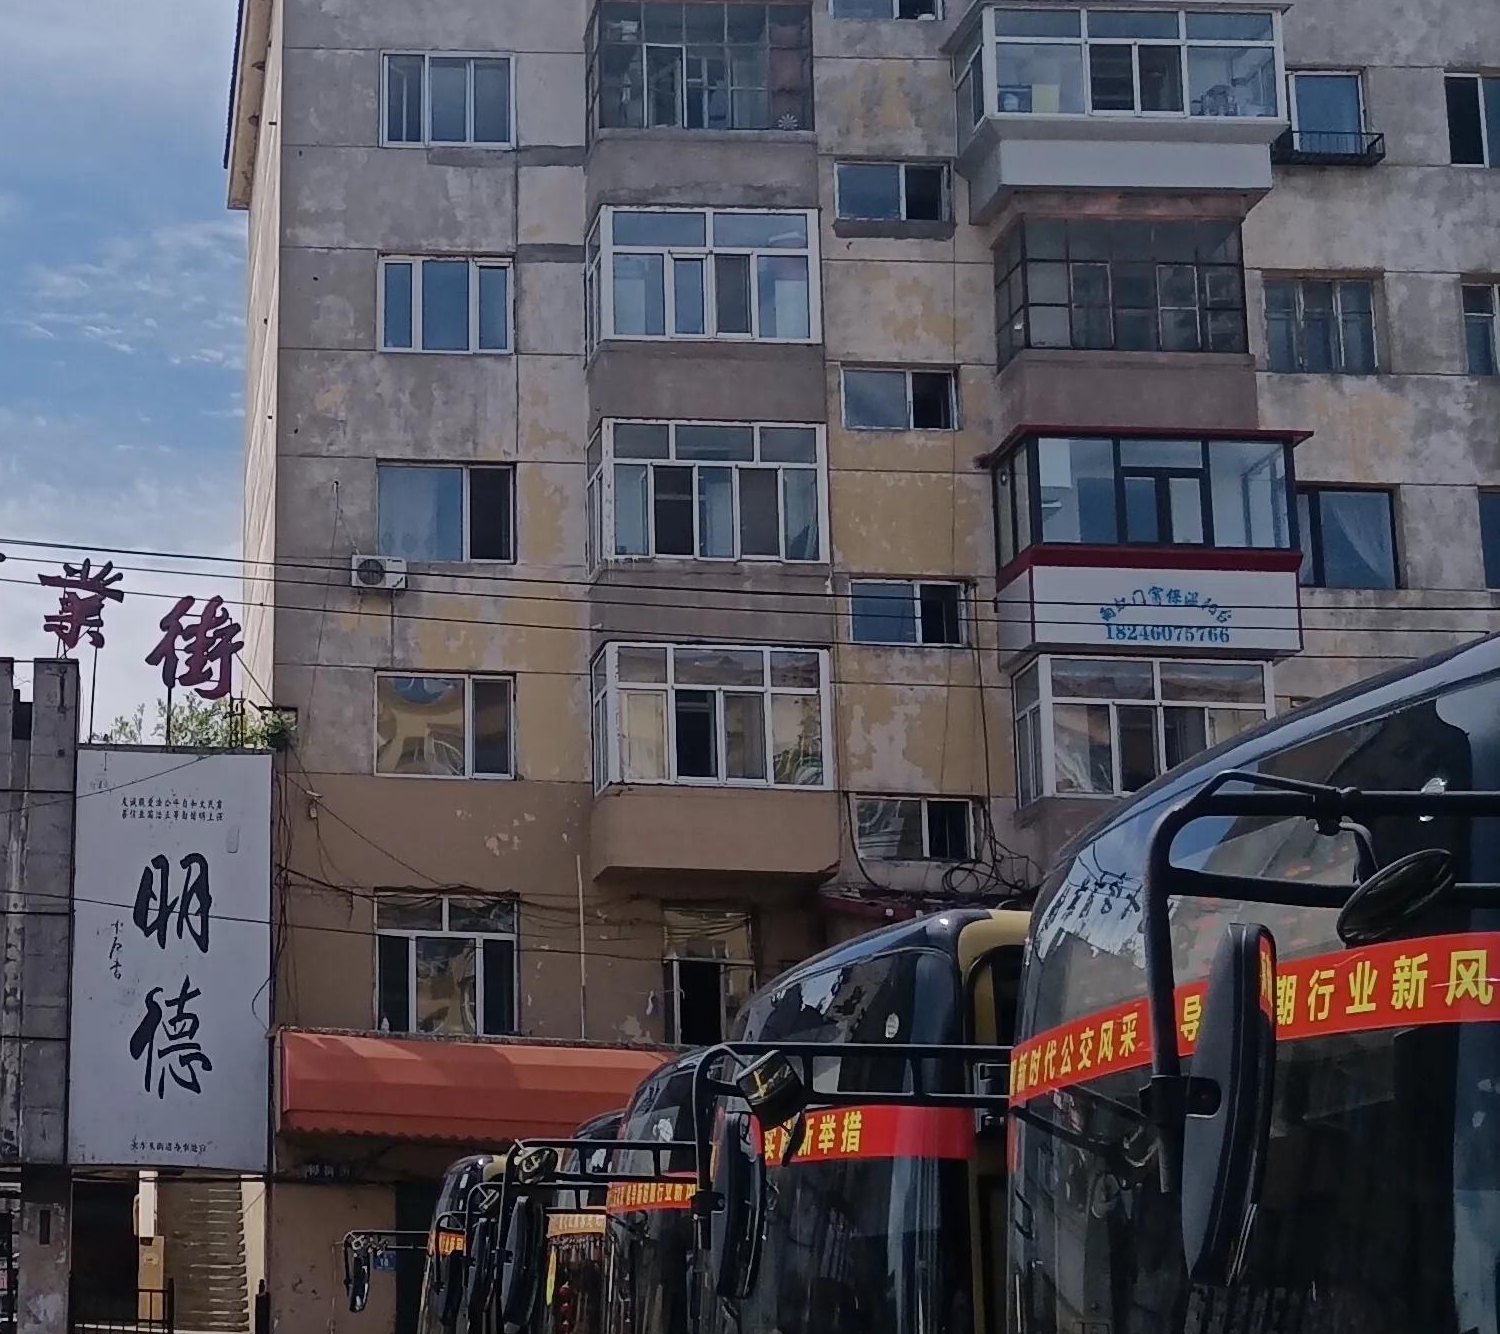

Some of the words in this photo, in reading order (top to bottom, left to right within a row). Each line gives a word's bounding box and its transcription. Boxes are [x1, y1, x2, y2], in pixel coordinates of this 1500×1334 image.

[130, 852, 213, 1100] 明德
[1010, 1012, 1138, 1097] 新时代公交风采
